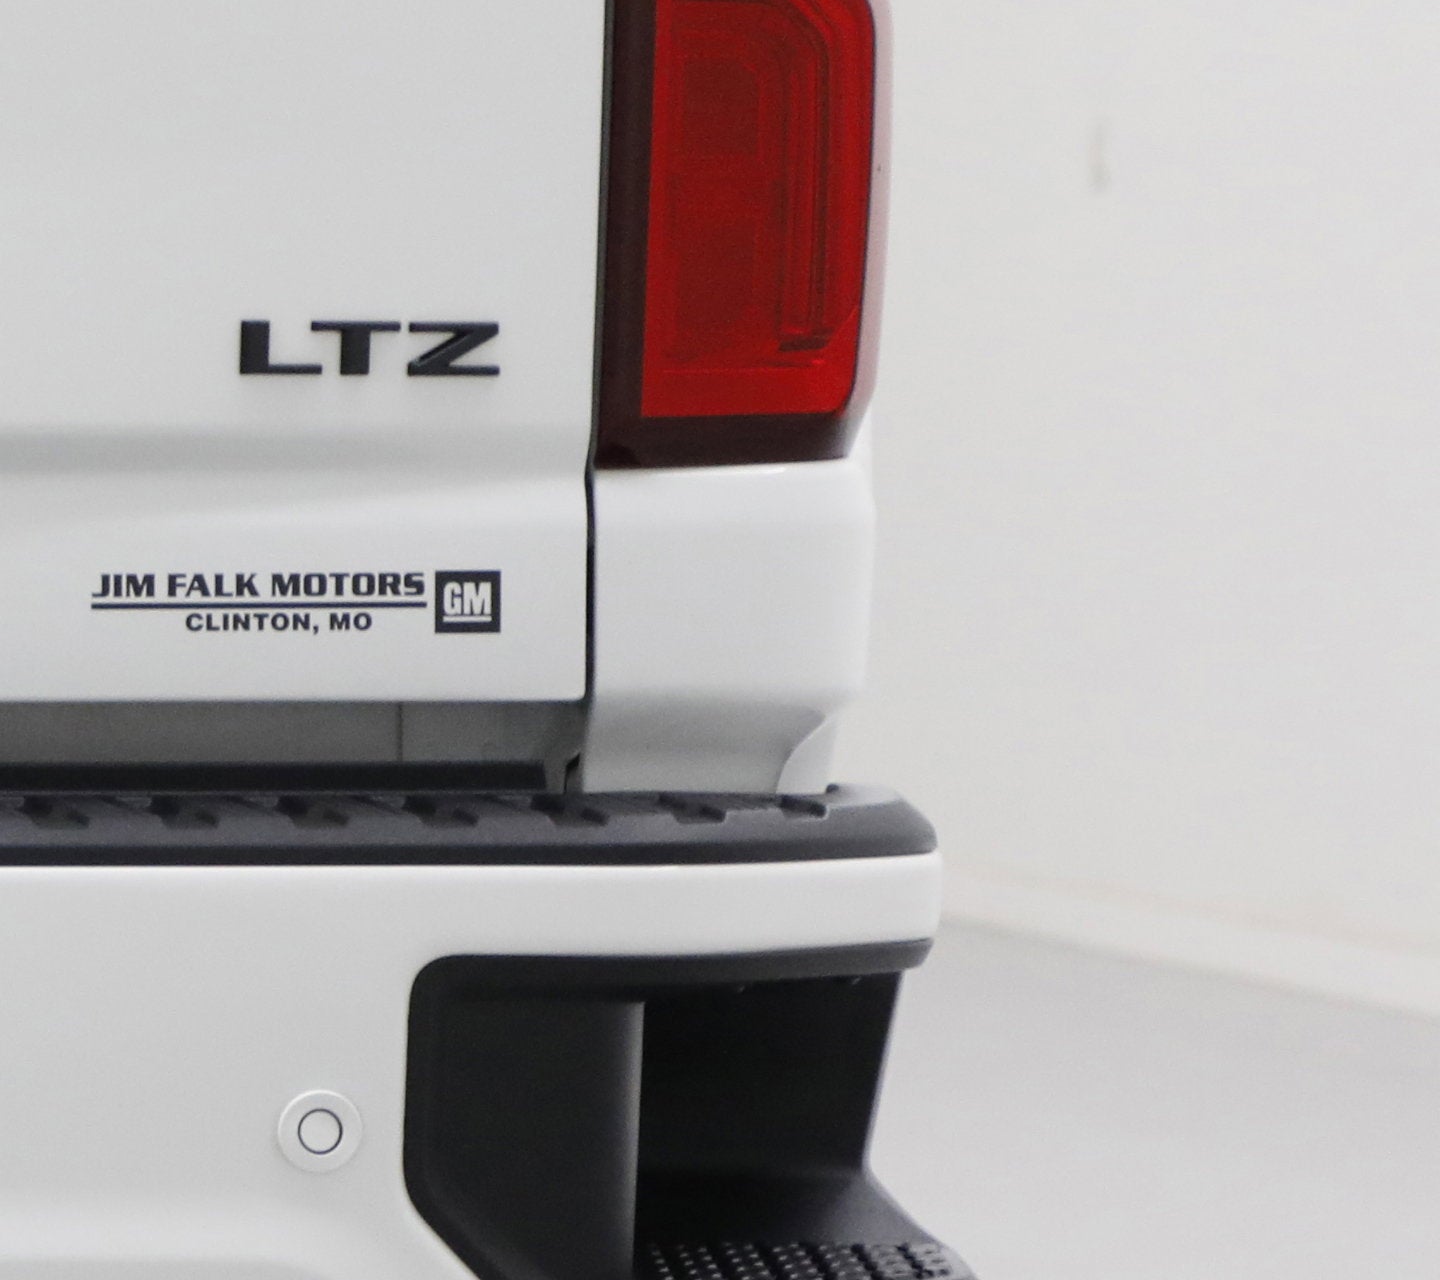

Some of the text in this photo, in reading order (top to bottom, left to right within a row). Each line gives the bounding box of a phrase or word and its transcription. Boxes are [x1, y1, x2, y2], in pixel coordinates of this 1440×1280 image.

[239, 319, 500, 376] LTZ
[92, 572, 425, 598] JIM FALK MOTORS
[443, 581, 492, 618] GM
[185, 613, 372, 634] CLINTON, MO
